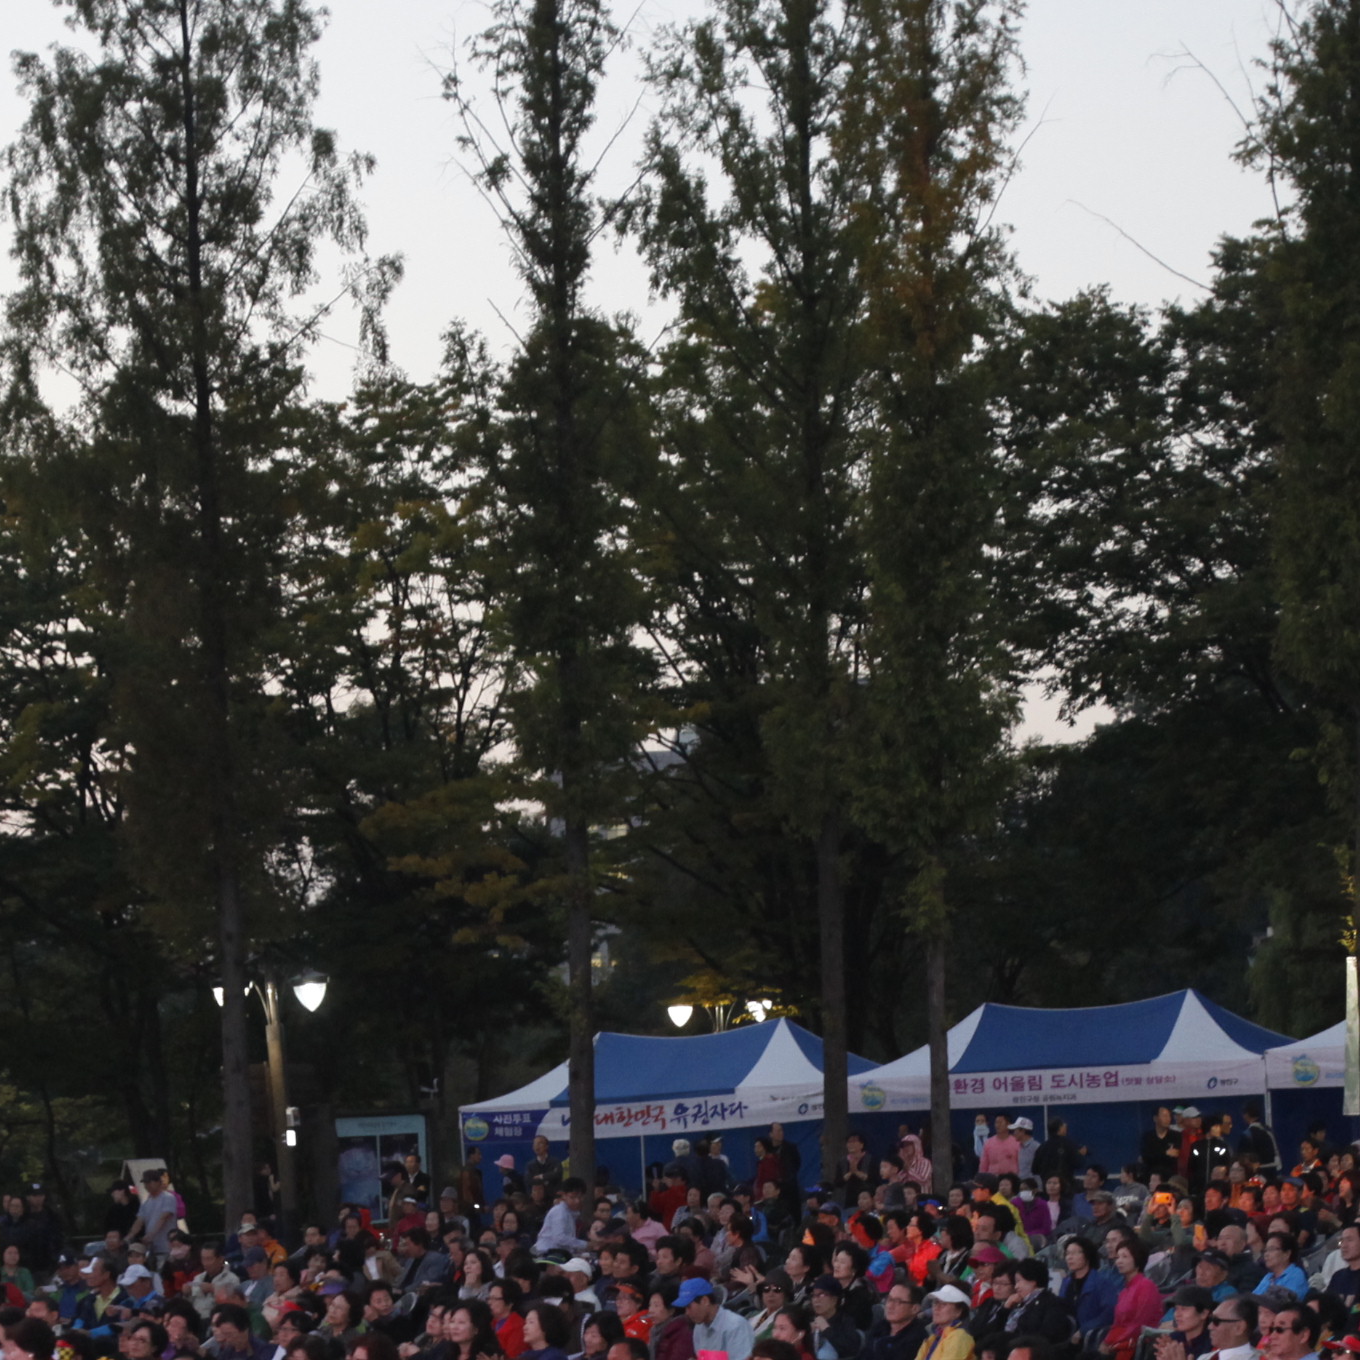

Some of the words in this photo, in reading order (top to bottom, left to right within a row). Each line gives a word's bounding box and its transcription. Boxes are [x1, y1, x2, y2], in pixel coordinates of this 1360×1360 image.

[952, 1077, 986, 1095] 환경
[992, 1075, 1043, 1092] 어울림
[1050, 1070, 1120, 1089] 도시농업
[492, 1112, 532, 1125] 사전투표
[594, 1104, 667, 1129] 대한민국
